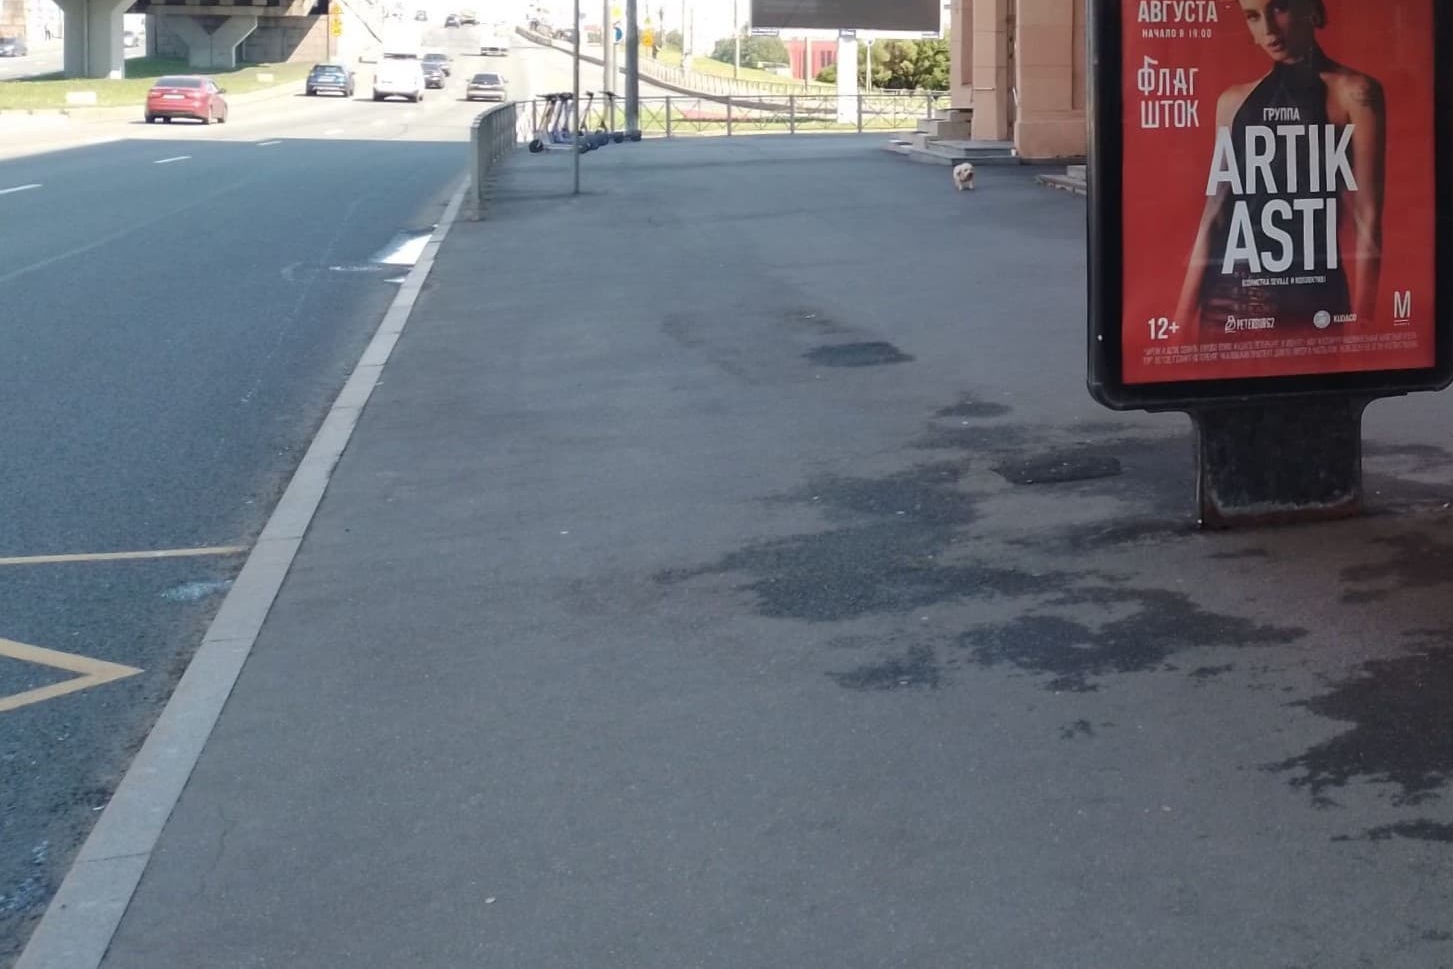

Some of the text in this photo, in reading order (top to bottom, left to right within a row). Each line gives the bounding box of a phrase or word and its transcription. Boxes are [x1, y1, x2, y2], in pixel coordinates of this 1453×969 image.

[1137, 0, 1219, 23] АВГУСТА
[1142, 29, 1177, 39] НАЧАЛО
[1137, 55, 1200, 96] ФЛАГ
[1141, 100, 1200, 128] ШТОК
[1263, 107, 1301, 122] ГРУППА
[1205, 123, 1359, 196] ARTIK
[1220, 197, 1339, 275] ASTI
[1148, 317, 1180, 340] 12+
